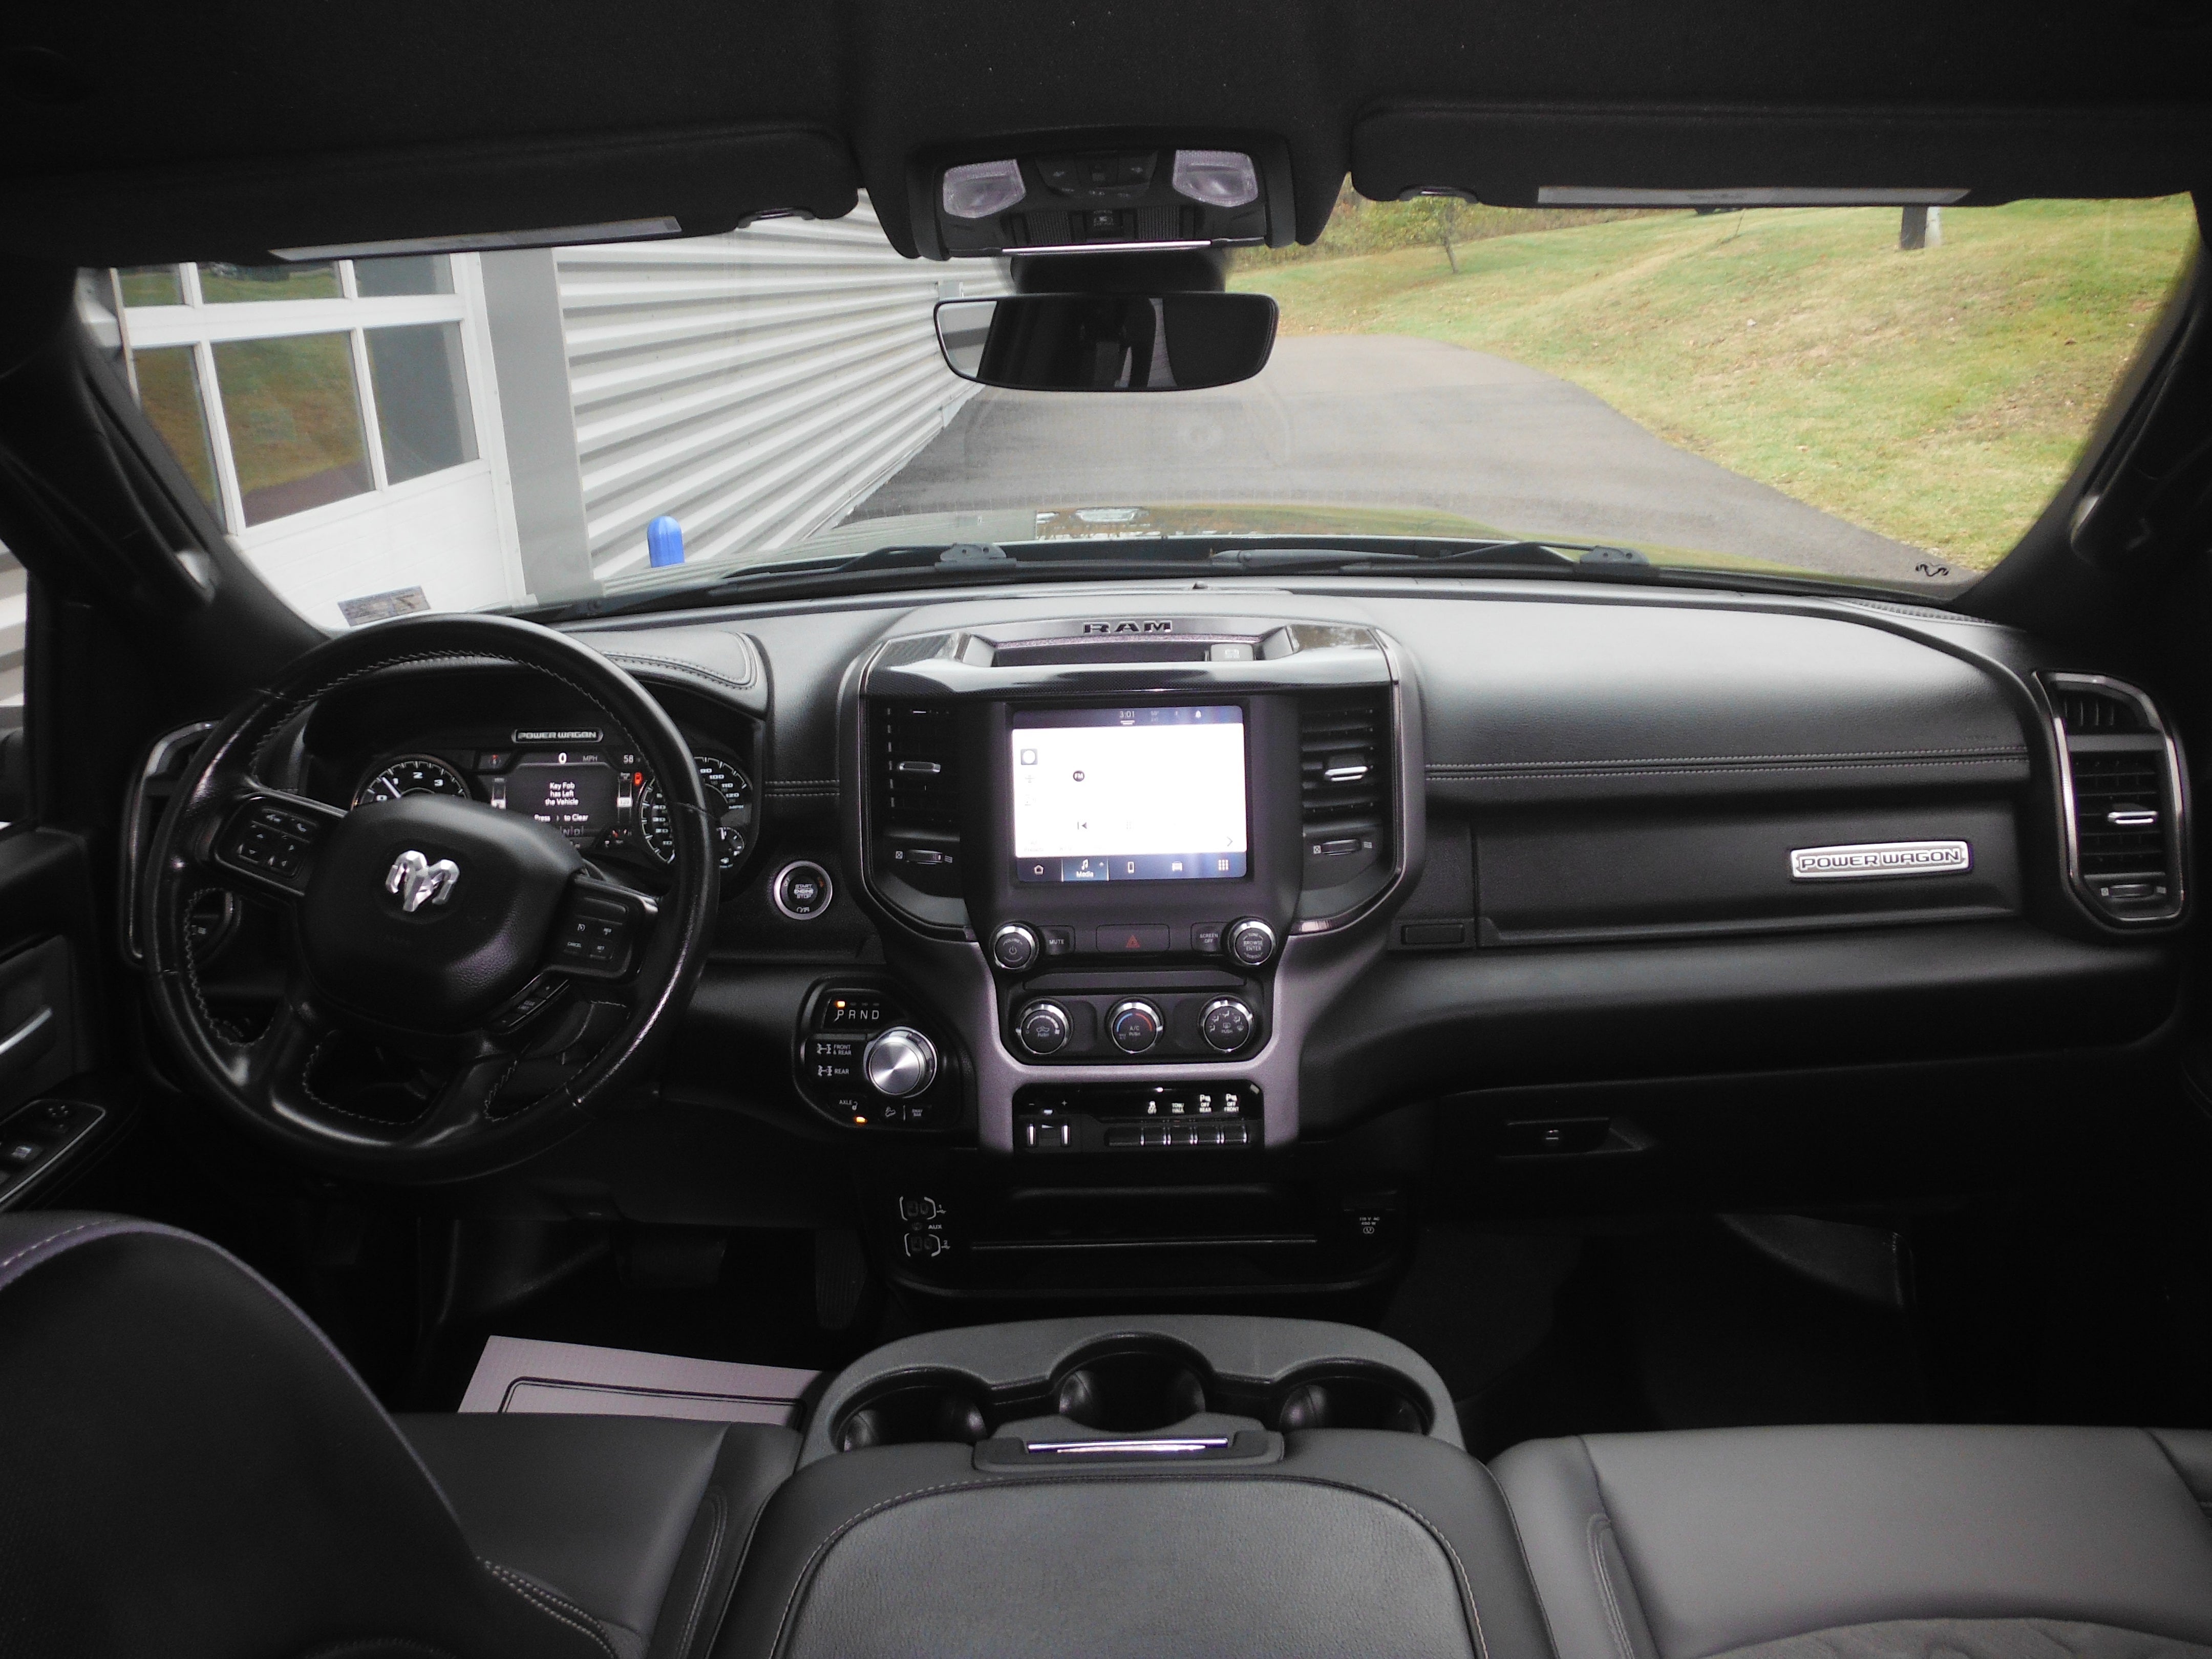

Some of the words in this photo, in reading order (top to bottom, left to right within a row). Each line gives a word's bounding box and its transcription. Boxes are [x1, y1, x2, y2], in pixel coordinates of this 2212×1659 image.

[1083, 620, 1173, 634] RAM
[559, 752, 567, 764] 0
[623, 755, 634, 764] 58
[549, 782, 562, 790] Key
[1801, 854, 1879, 869] POWER
[1882, 849, 1960, 865] WAGON
